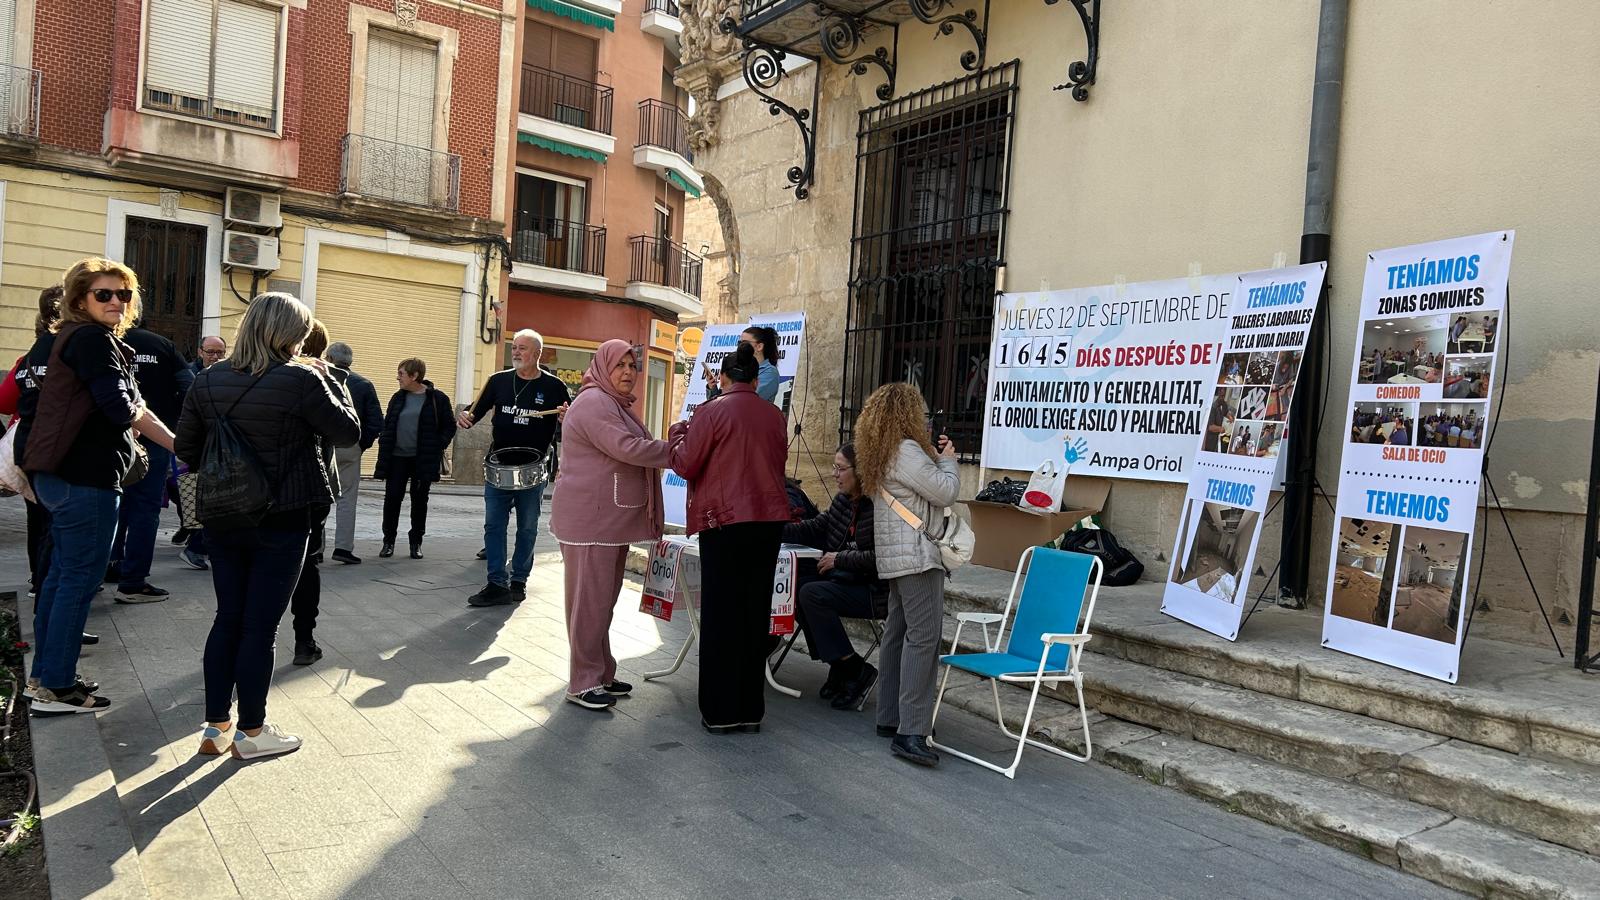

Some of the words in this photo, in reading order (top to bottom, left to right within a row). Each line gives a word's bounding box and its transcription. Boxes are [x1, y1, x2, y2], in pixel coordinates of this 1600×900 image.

[1386, 254, 1480, 290] TENÍAMOS
[1246, 281, 1307, 309] TENÍAMOS
[1377, 294, 1418, 315] ZONAS
[1419, 287, 1485, 311] COMUNES
[1001, 307, 1055, 330] JUEVES
[1058, 306, 1075, 329] 12
[1077, 304, 1097, 328] DE
[1099, 295, 1203, 327] SEPTIEMBRE
[1206, 292, 1230, 320] DE
[1231, 312, 1267, 330] TALLERES
[1266, 308, 1313, 327] LABORALES
[776, 320, 803, 332] DERECHO
[710, 333, 741, 348] TENÍAMO
[1229, 334, 1236, 350] Y
[1235, 334, 1246, 349] DE
[1245, 334, 1255, 349] LA
[1256, 332, 1275, 348] VIDA
[1275, 330, 1305, 348] DIARIA
[134, 354, 158, 364] MERAL
[1000, 342, 1068, 365] 1645
[1075, 343, 1112, 367] DÍAS
[1114, 340, 1187, 367] DESPUÉS
[1190, 343, 1213, 365] DE
[993, 381, 1090, 403] AYUNTAMIENTO
[1094, 381, 1103, 404] Y
[1105, 380, 1203, 408] GENERALITAT,
[1376, 386, 1421, 400] COMEDOR
[991, 406, 1002, 427] EL
[1004, 406, 1040, 429] ORIOL
[1041, 407, 1077, 431] EXIGE
[1077, 408, 1118, 432] ASILO
[1120, 409, 1130, 433] Y
[1130, 410, 1202, 435] PALMERAL
[1089, 451, 1140, 472] Ampa
[1143, 454, 1183, 472] Oriol
[1382, 446, 1406, 461] SALA
[1407, 448, 1420, 462] DE
[1421, 448, 1447, 464] OCIO
[1205, 478, 1256, 507] TENEMOS
[1366, 489, 1450, 523] TENEMOS
[652, 560, 675, 580] Oriol
